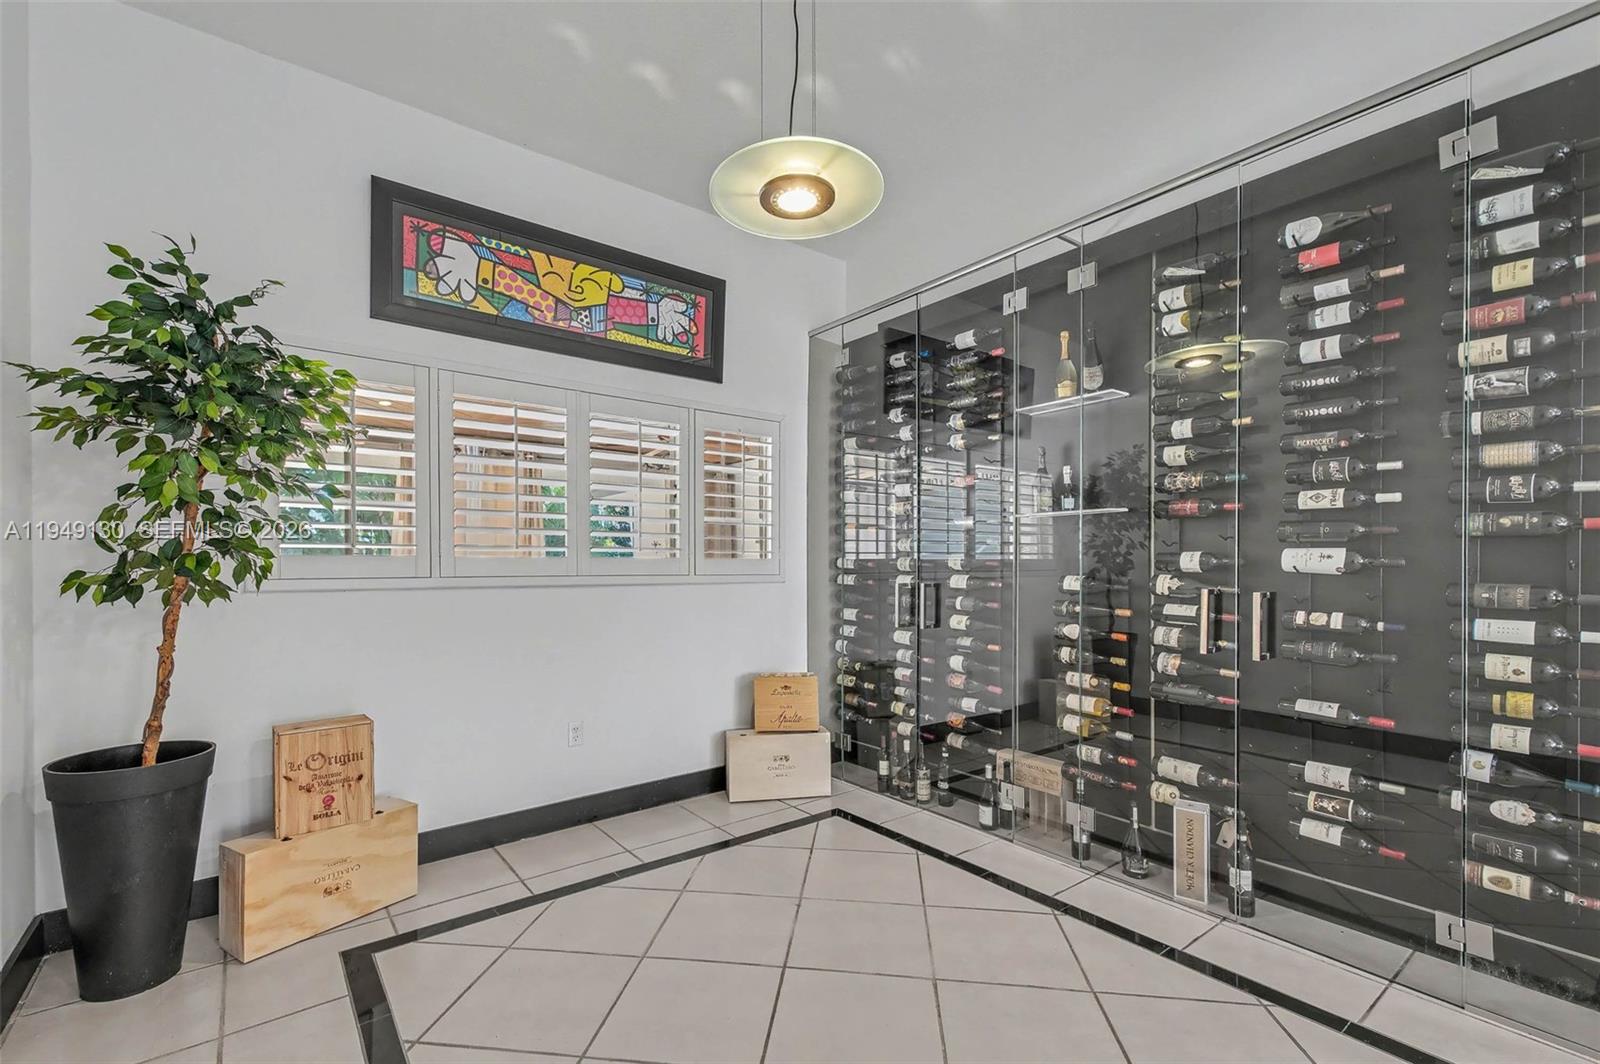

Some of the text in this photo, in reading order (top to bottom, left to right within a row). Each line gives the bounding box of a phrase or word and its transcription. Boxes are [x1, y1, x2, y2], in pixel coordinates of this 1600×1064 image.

[305, 751, 364, 772] Origini
[312, 809, 342, 821] BOLLA
[1185, 817, 1195, 860] CHANDON
